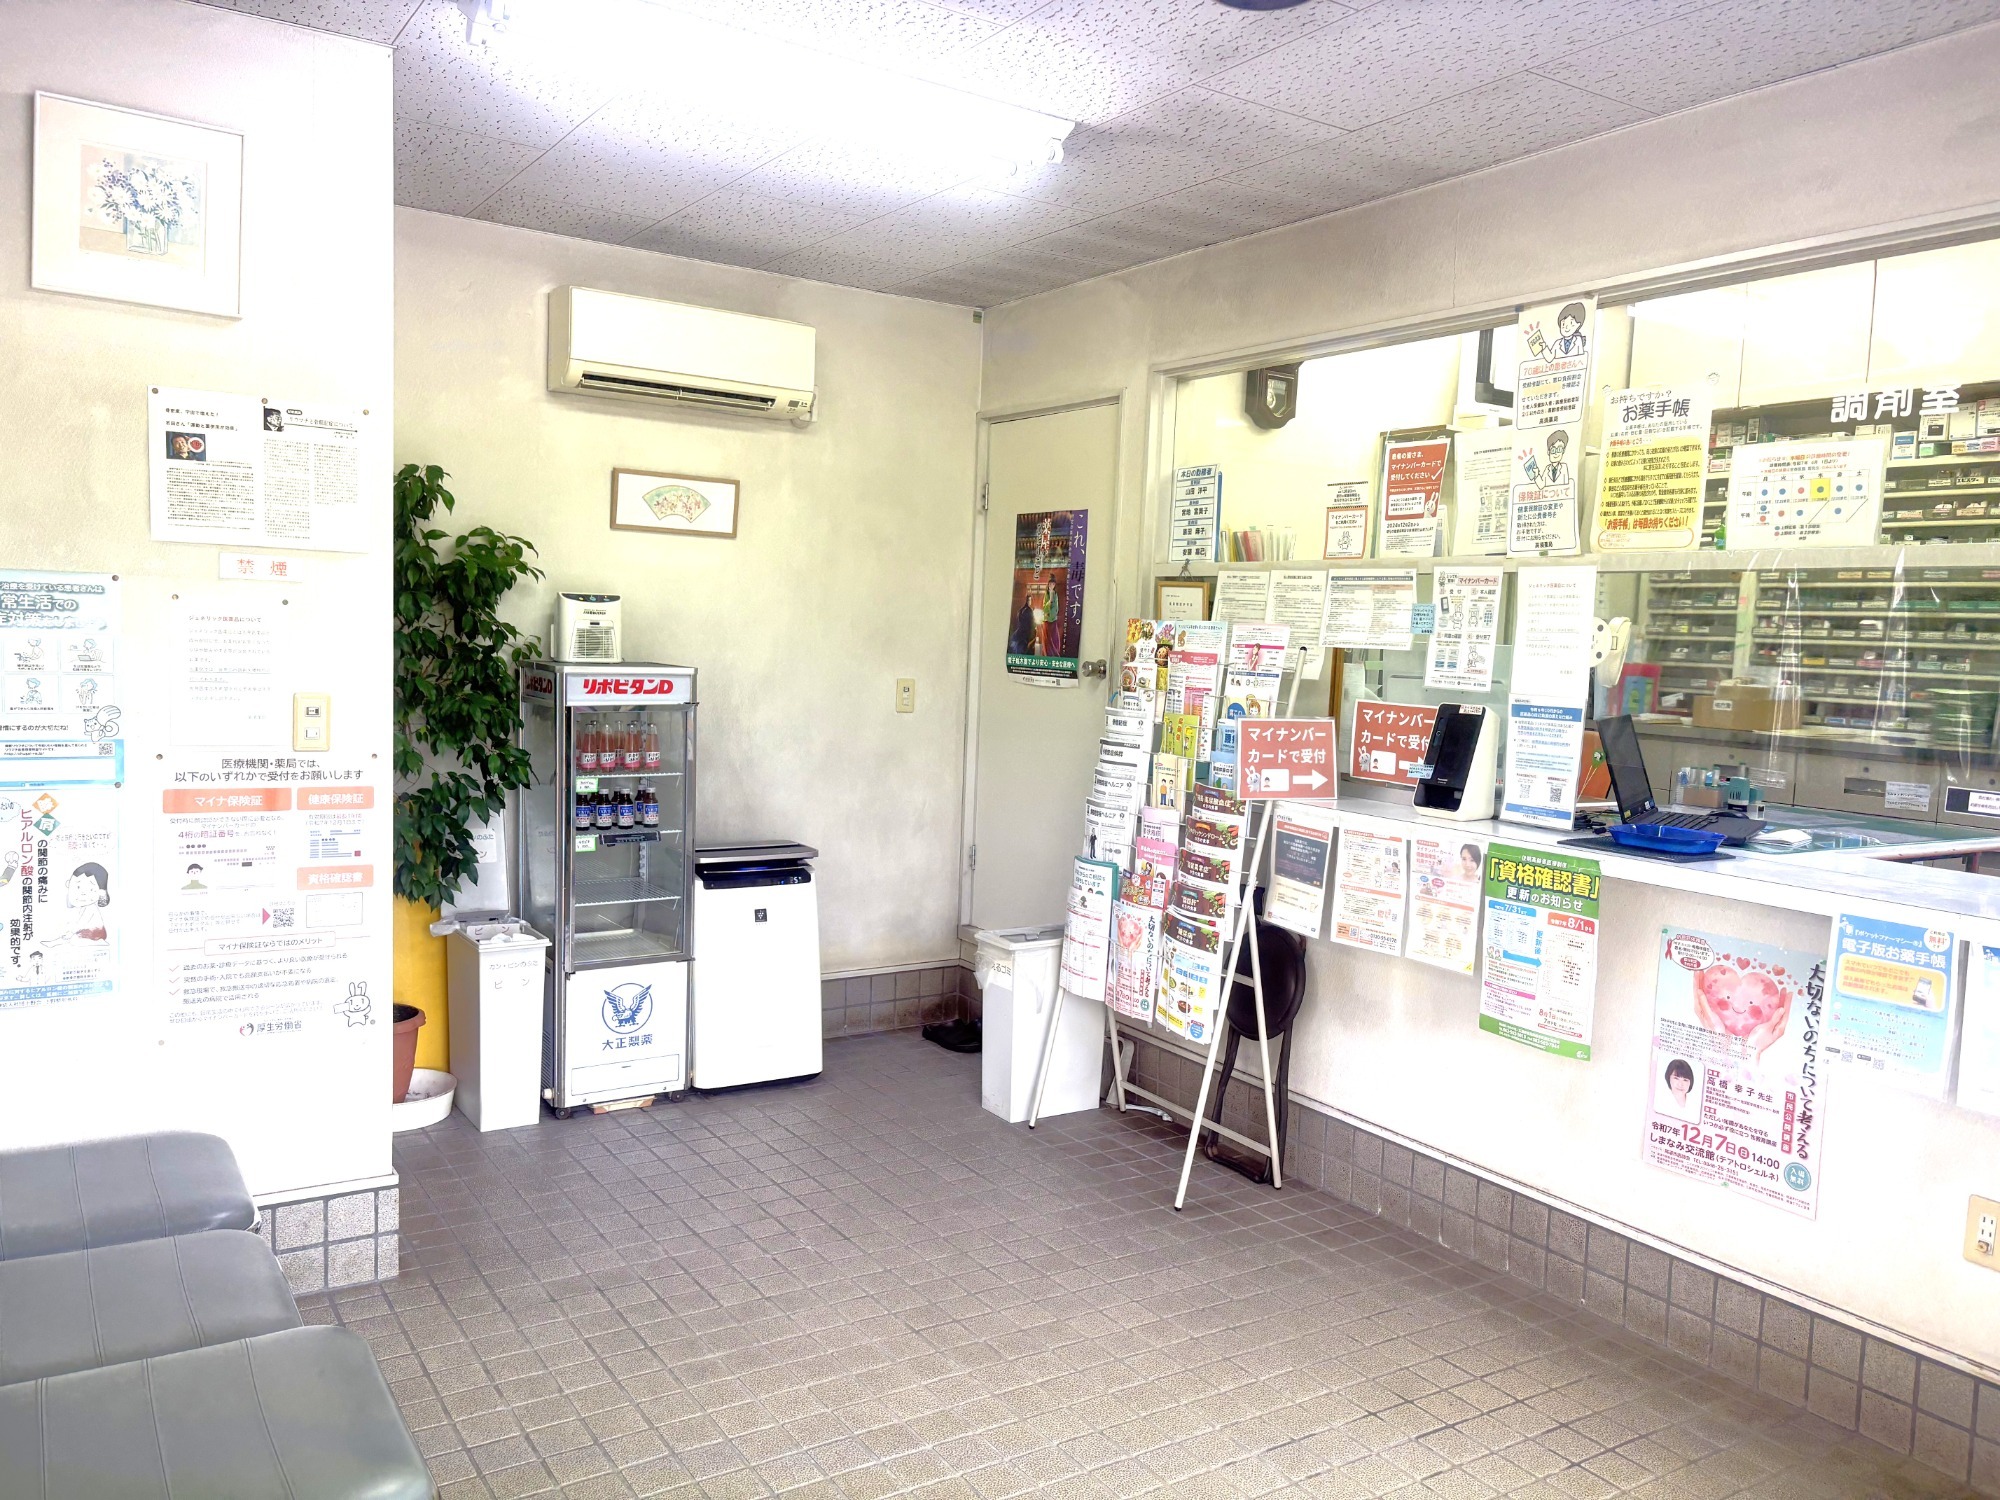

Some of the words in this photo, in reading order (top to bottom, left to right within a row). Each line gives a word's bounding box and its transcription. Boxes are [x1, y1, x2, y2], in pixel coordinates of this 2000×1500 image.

[1523, 360, 1584, 376] 70歳以上の患者さんへ
[1610, 390, 1672, 405] お持ちですか？
[1831, 384, 1961, 423] 調剤室
[1622, 398, 1690, 423] お薬手帳
[1391, 460, 1441, 470] マイナンバーカードで
[1390, 472, 1430, 481] 受付してください
[1518, 487, 1570, 502] 保険証について
[1070, 514, 1085, 625] これ、毒です。
[582, 678, 674, 695] リポビタンD
[1362, 709, 1435, 728] マイナンバー
[1247, 727, 1326, 742] マイナンバー
[221, 758, 320, 769] 医療機関・薬局では、
[1247, 748, 1326, 764] カードで受付
[174, 770, 363, 782] 以下のいずれかで受付をお願いします
[194, 795, 263, 807] マイナ保険証
[308, 793, 364, 805] 健康保険証
[1521, 854, 1568, 868] 後期高齢者医療制度
[20, 809, 34, 941] ヒアルロン酸の関節内注射が
[307, 872, 363, 884] 資格確認書
[1489, 858, 1600, 899] 「資格確認書」
[1506, 886, 1583, 912] 更新のお知らせ
[10, 919, 21, 968] 効果的です。
[218, 938, 323, 950] マイナ保険証ならではのメリット
[1534, 930, 1543, 955] 更新後
[1842, 938, 1946, 969] 電子版お薬手帳
[256, 1021, 302, 1033] 厚生労働省
[601, 1034, 653, 1051] 大正製薬
[1796, 963, 1825, 1161] 大切ないのちについて考える
[1757, 1092, 1773, 1103] 先生
[1780, 1091, 1796, 1154] 市民公開講座
[1751, 1152, 1780, 1170] 14:00
